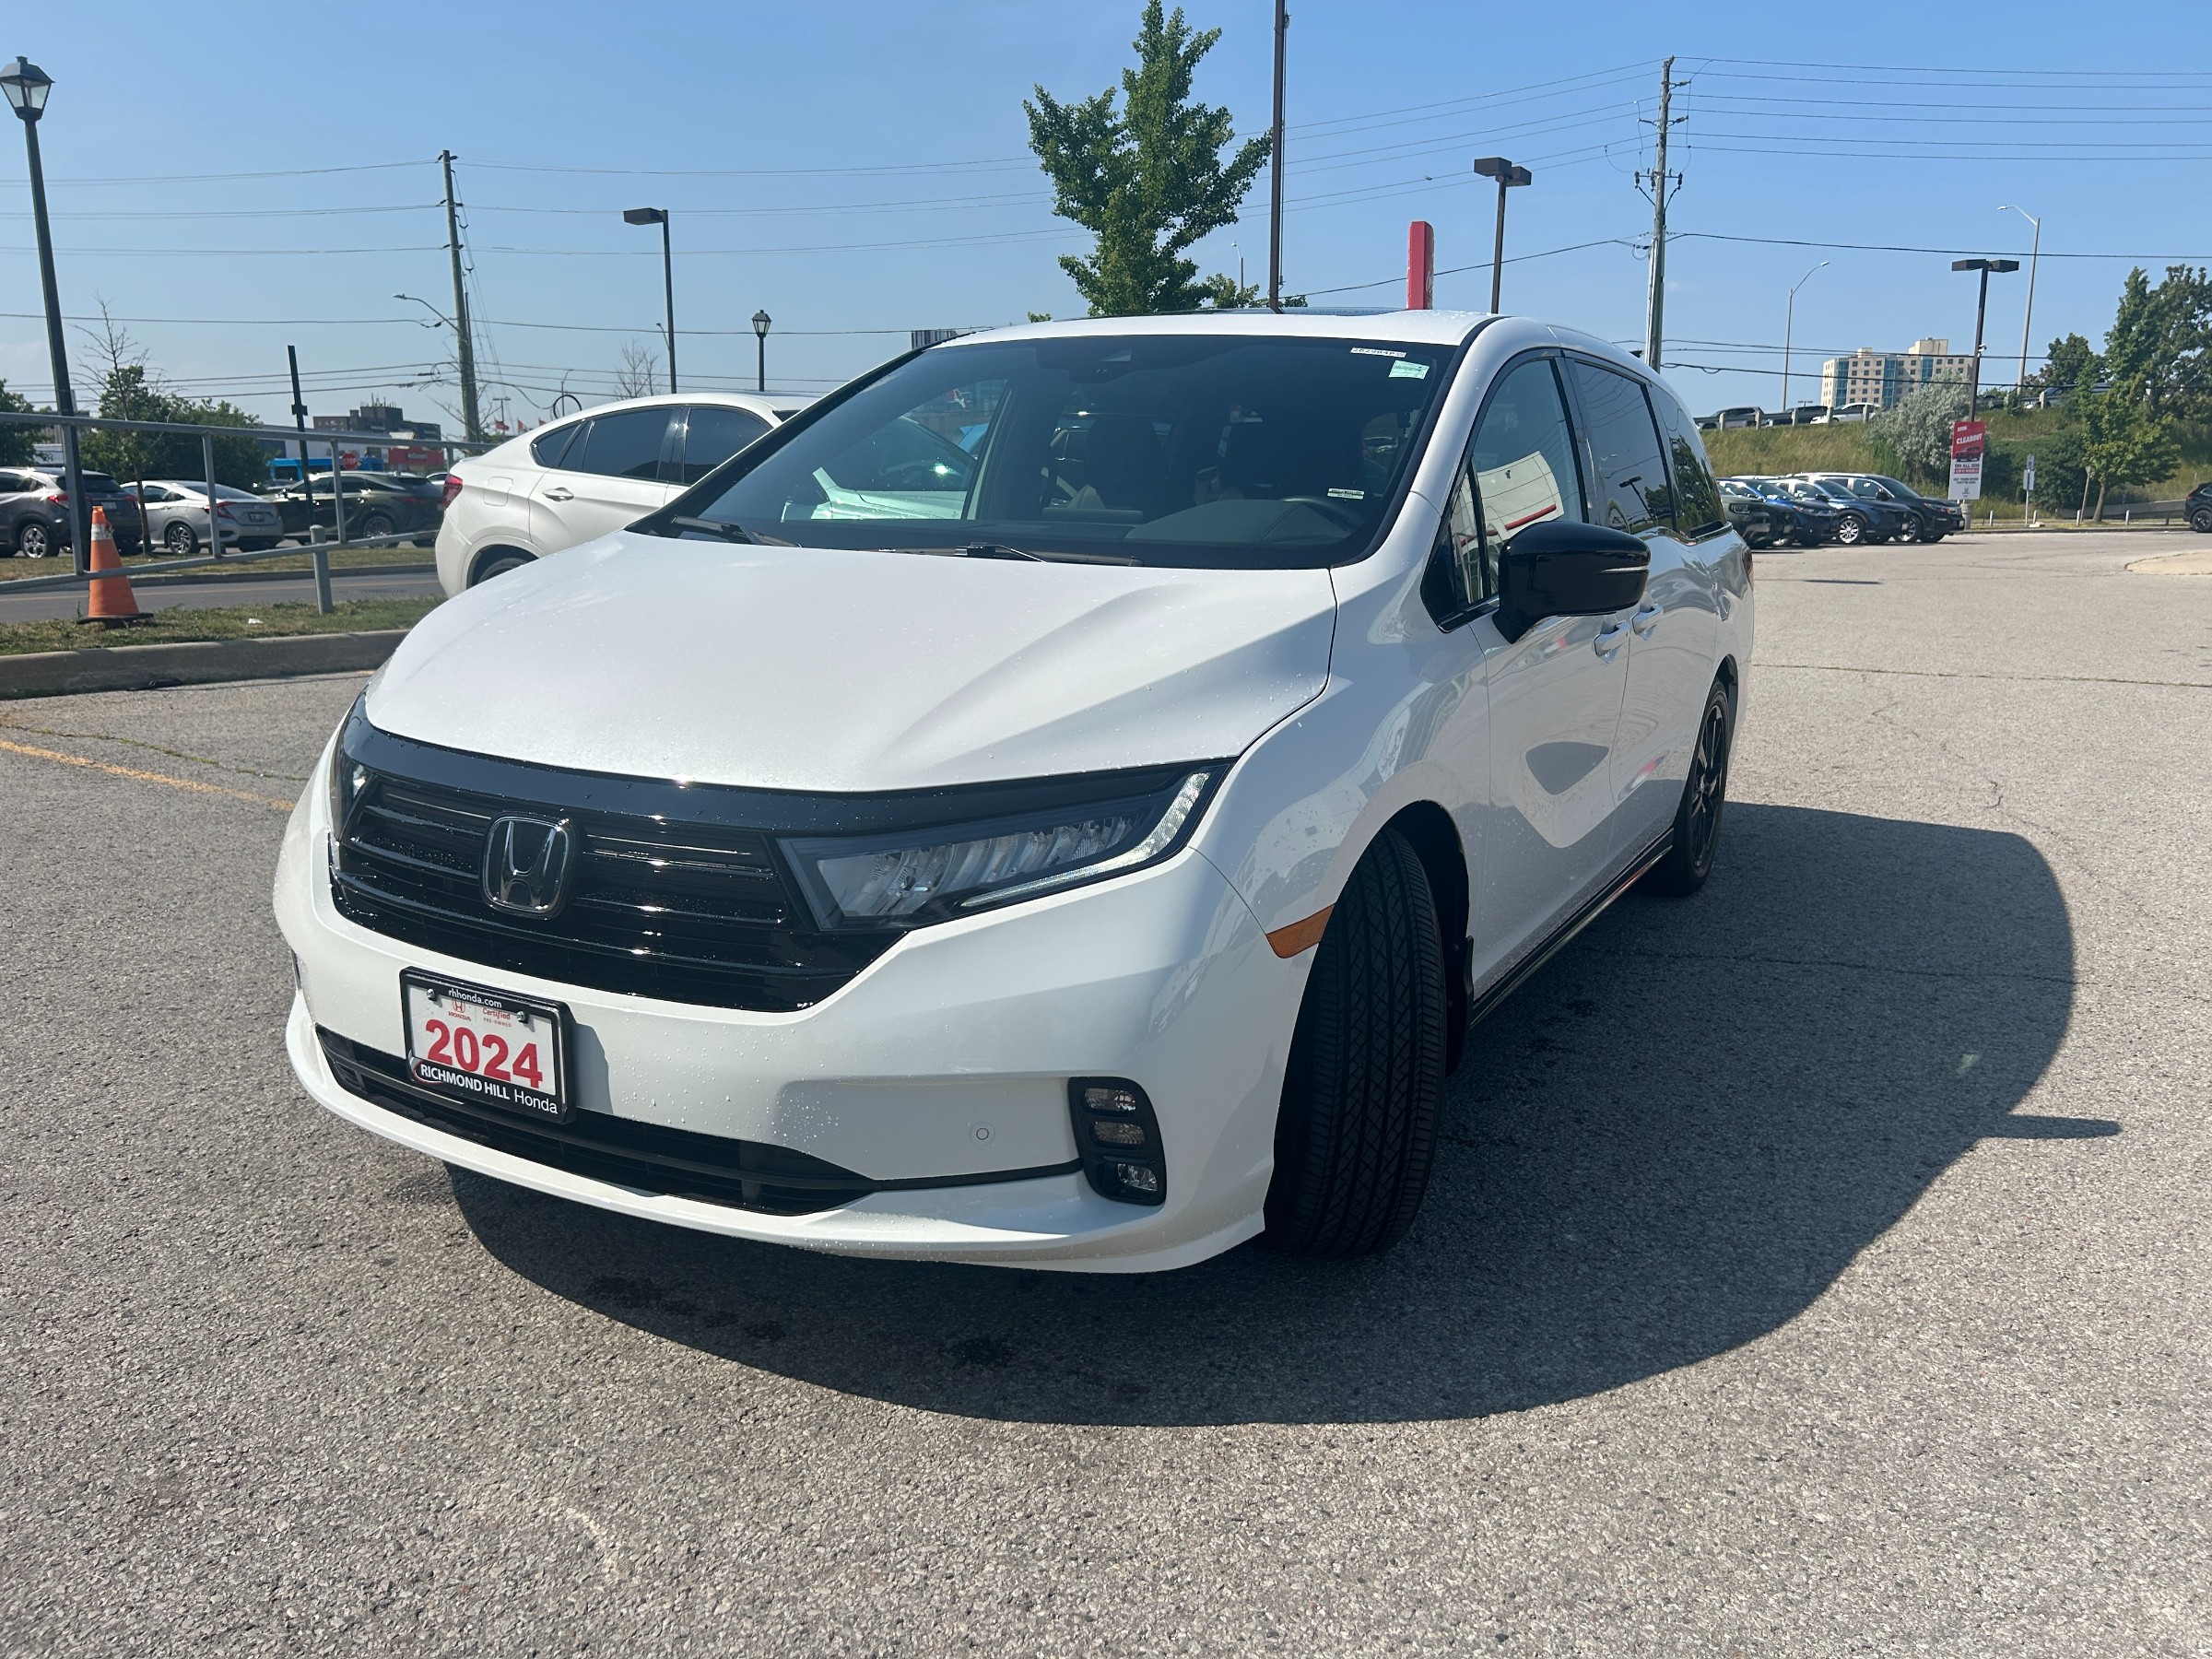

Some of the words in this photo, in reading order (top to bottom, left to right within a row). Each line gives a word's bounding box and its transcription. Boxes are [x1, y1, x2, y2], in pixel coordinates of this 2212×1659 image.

[1956, 433, 1983, 444] CLEAROUT
[448, 987, 502, 1009] rhhonda.com
[448, 1010, 472, 1021] HONDA
[482, 1006, 512, 1020] Certified
[483, 1017, 512, 1028] PRE-OWNED
[425, 1018, 544, 1089] 2024
[420, 1064, 483, 1092] RICHMOND
[484, 1081, 511, 1100] HILL
[513, 1088, 559, 1115] Honda
